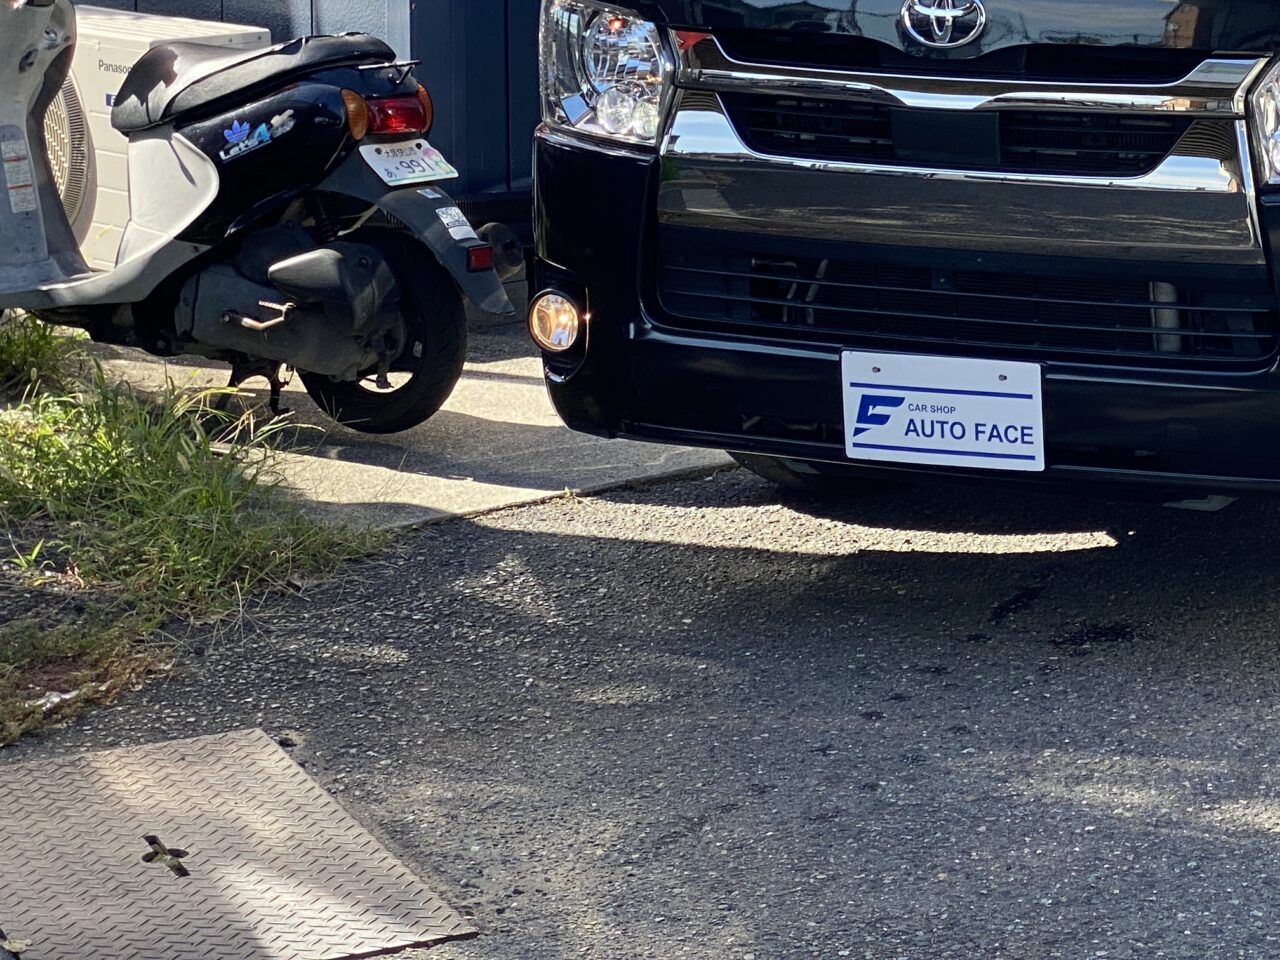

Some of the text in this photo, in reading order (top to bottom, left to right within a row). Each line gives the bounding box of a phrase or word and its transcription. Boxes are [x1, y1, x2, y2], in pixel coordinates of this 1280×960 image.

[98, 59, 132, 74] Panaso
[908, 403, 956, 415] CAR SHOP
[904, 418, 1035, 445] AUTO FACE
